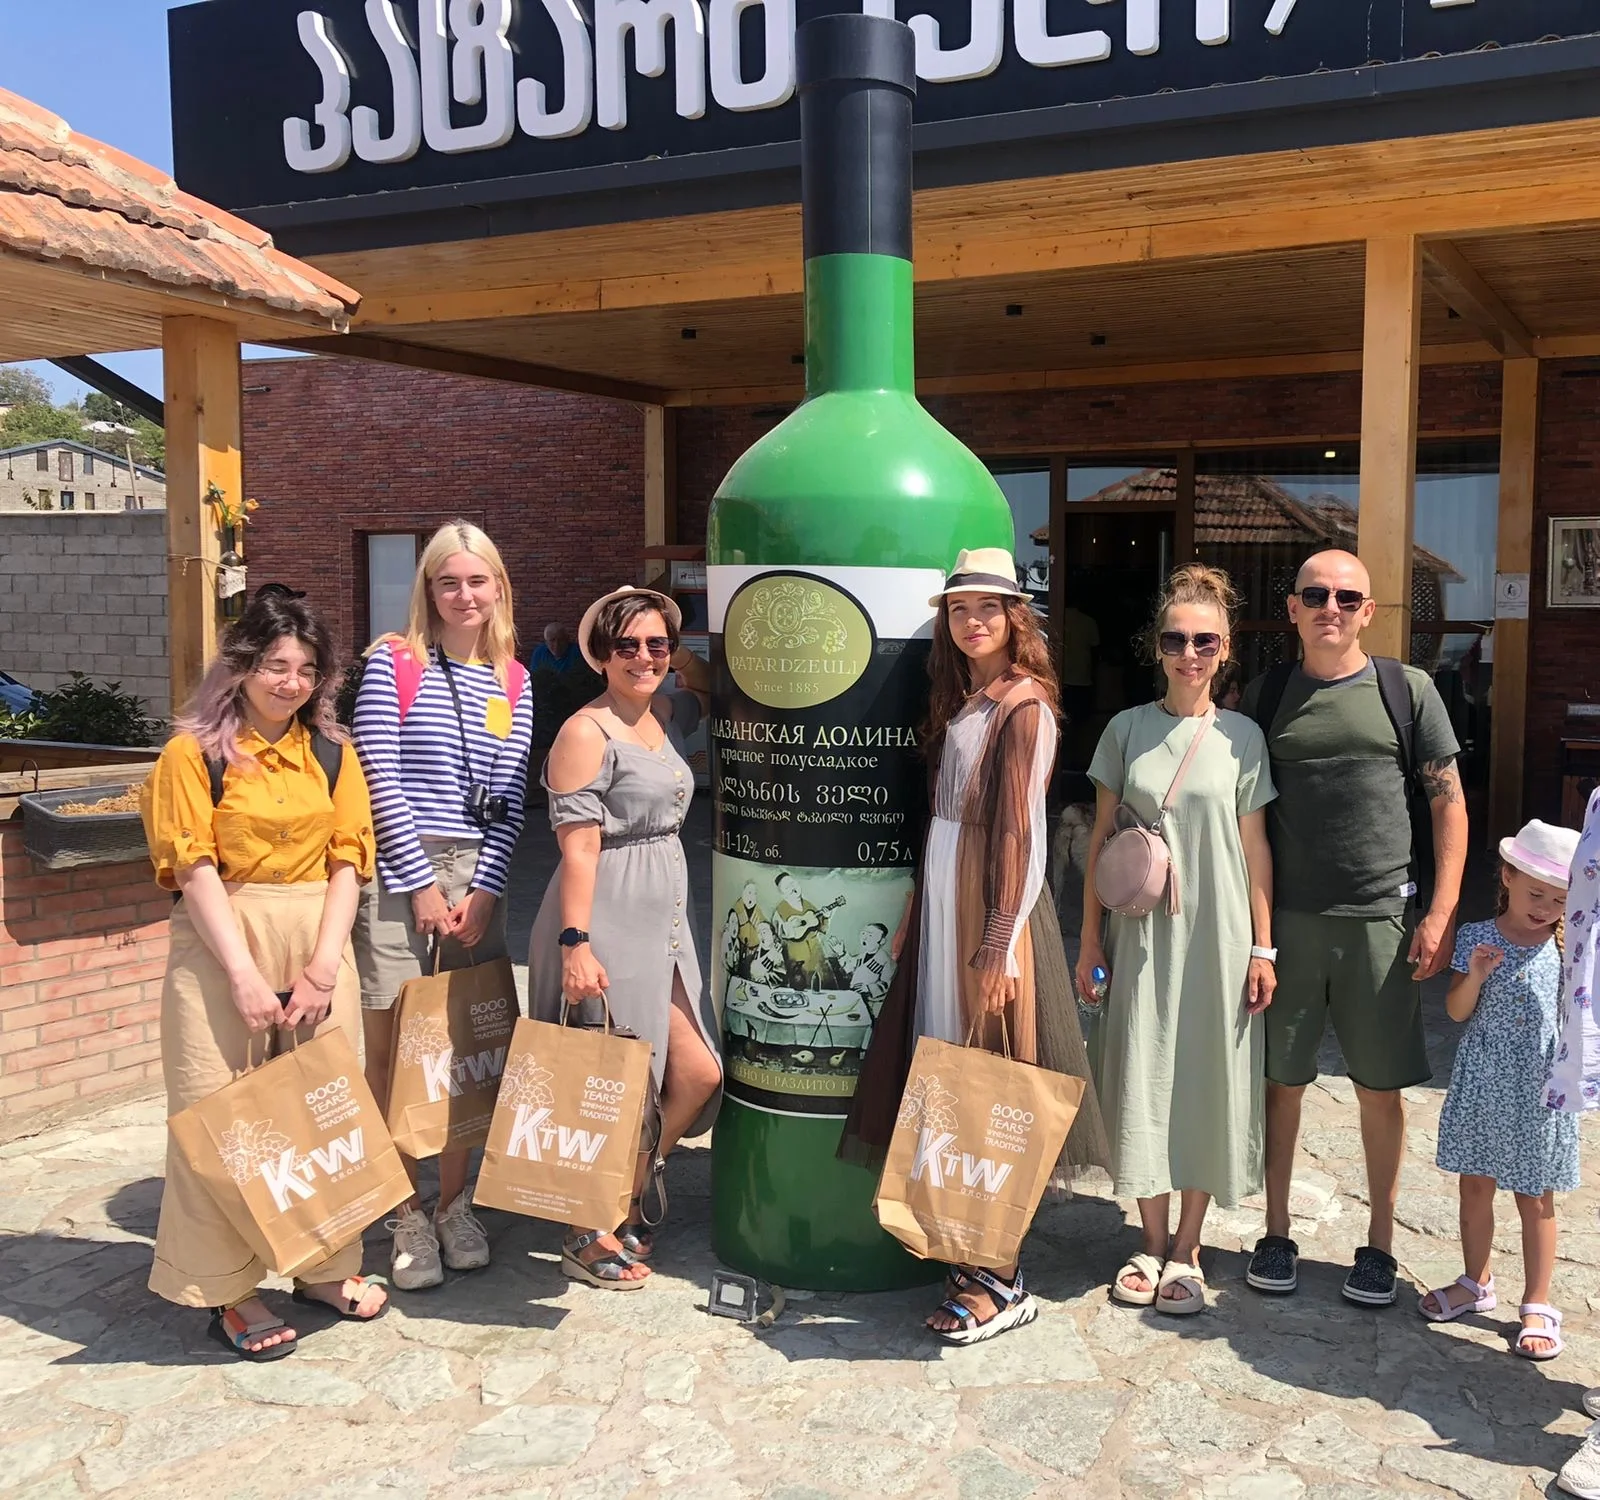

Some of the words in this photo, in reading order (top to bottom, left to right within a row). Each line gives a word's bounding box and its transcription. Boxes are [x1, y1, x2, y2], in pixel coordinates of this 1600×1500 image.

[731, 655, 857, 675] PATARDZEULI
[753, 680, 783, 693] Since
[789, 682, 820, 695] 1885
[711, 717, 804, 745] ЛАЗАНСКАЯ
[813, 725, 918, 749] ДОЛИНА
[721, 747, 765, 765] красное
[771, 753, 879, 772] полусладкое
[718, 776, 801, 804] ალაზნის
[816, 784, 889, 806] ველი
[796, 811, 853, 824] ტკბილი
[859, 810, 905, 824] ღვინო
[720, 830, 760, 859] 11-12%
[764, 844, 783, 859] об.
[857, 840, 900, 865] 0,75
[903, 847, 913, 861] л
[470, 998, 507, 1016] 8000
[471, 1011, 503, 1026] YEARS
[305, 1076, 349, 1105] 8000
[585, 1075, 626, 1094] 8000
[761, 1072, 769, 1085] И
[774, 1075, 836, 1091] РАЗЛИТО
[310, 1091, 348, 1115] YEARS
[583, 1088, 616, 1105] YEARS
[317, 1104, 361, 1132] TRADITION
[579, 1108, 619, 1123] TRADITION
[991, 1103, 1034, 1124] 8000
[989, 1116, 1024, 1135] YEARS
[984, 1136, 1026, 1155] TRADITION
[330, 1161, 369, 1183] GROUP
[557, 1160, 593, 1172] GROUP
